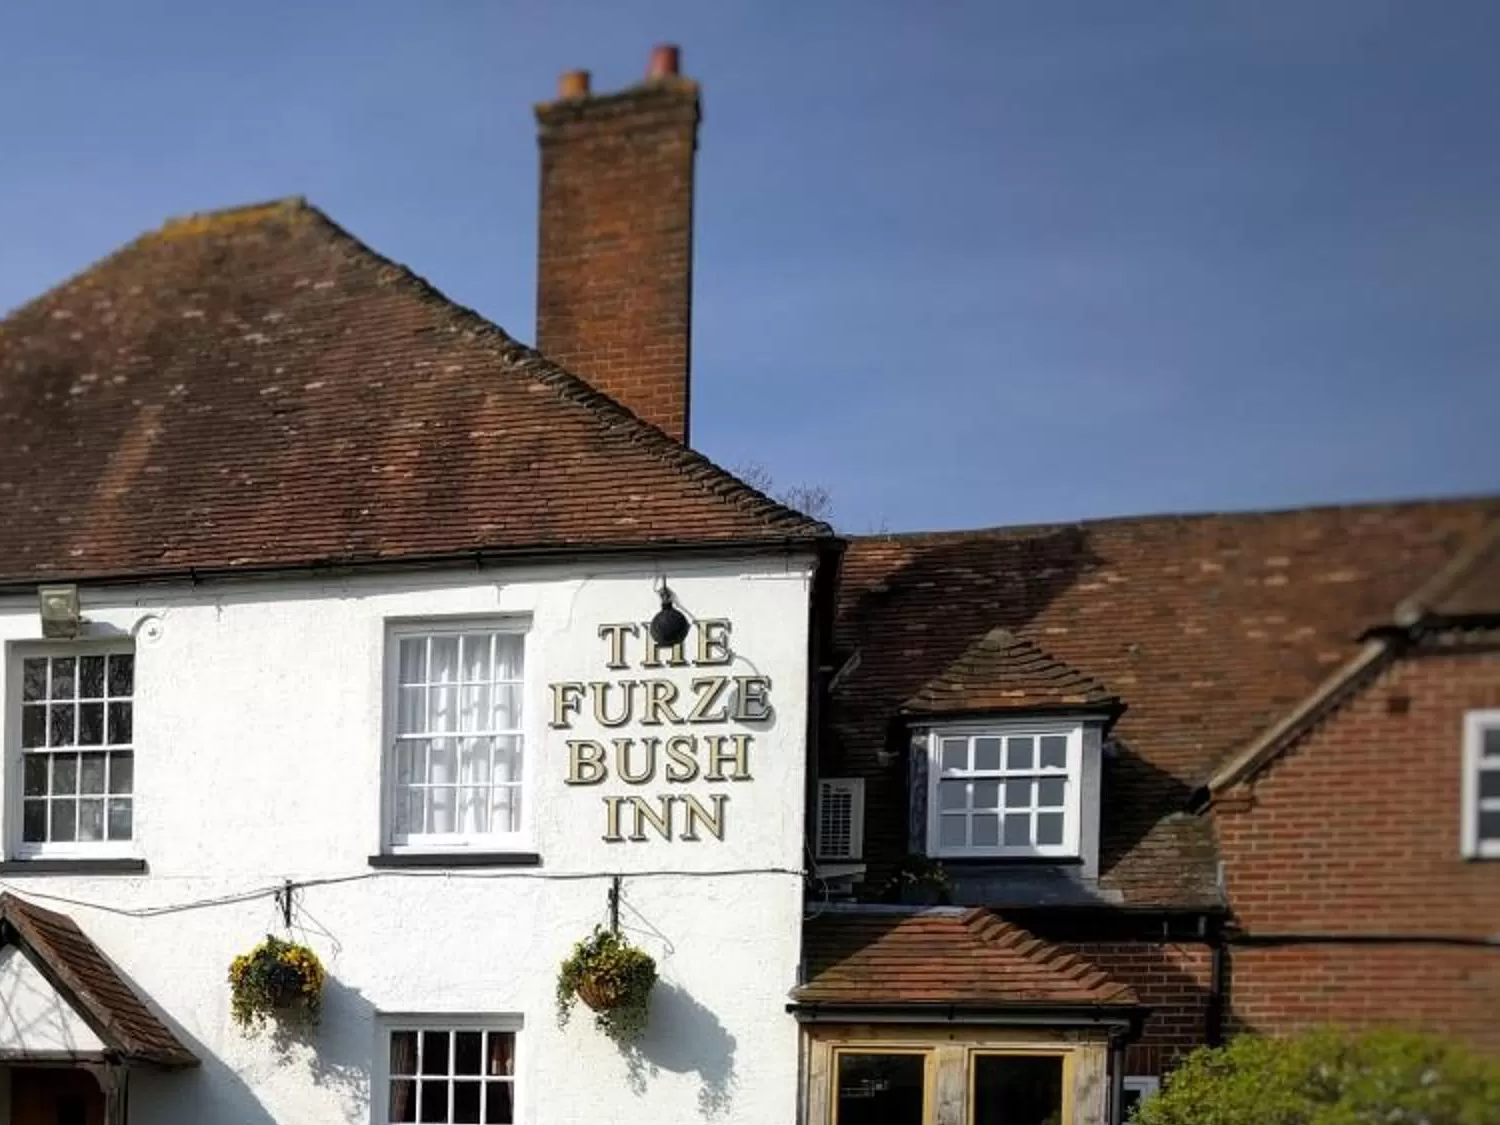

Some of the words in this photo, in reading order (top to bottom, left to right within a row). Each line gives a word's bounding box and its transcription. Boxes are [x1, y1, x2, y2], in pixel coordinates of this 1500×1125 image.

[598, 617, 733, 669] THE
[548, 675, 773, 729] FURZE
[564, 734, 753, 786] BUSH
[602, 793, 729, 843] INN
